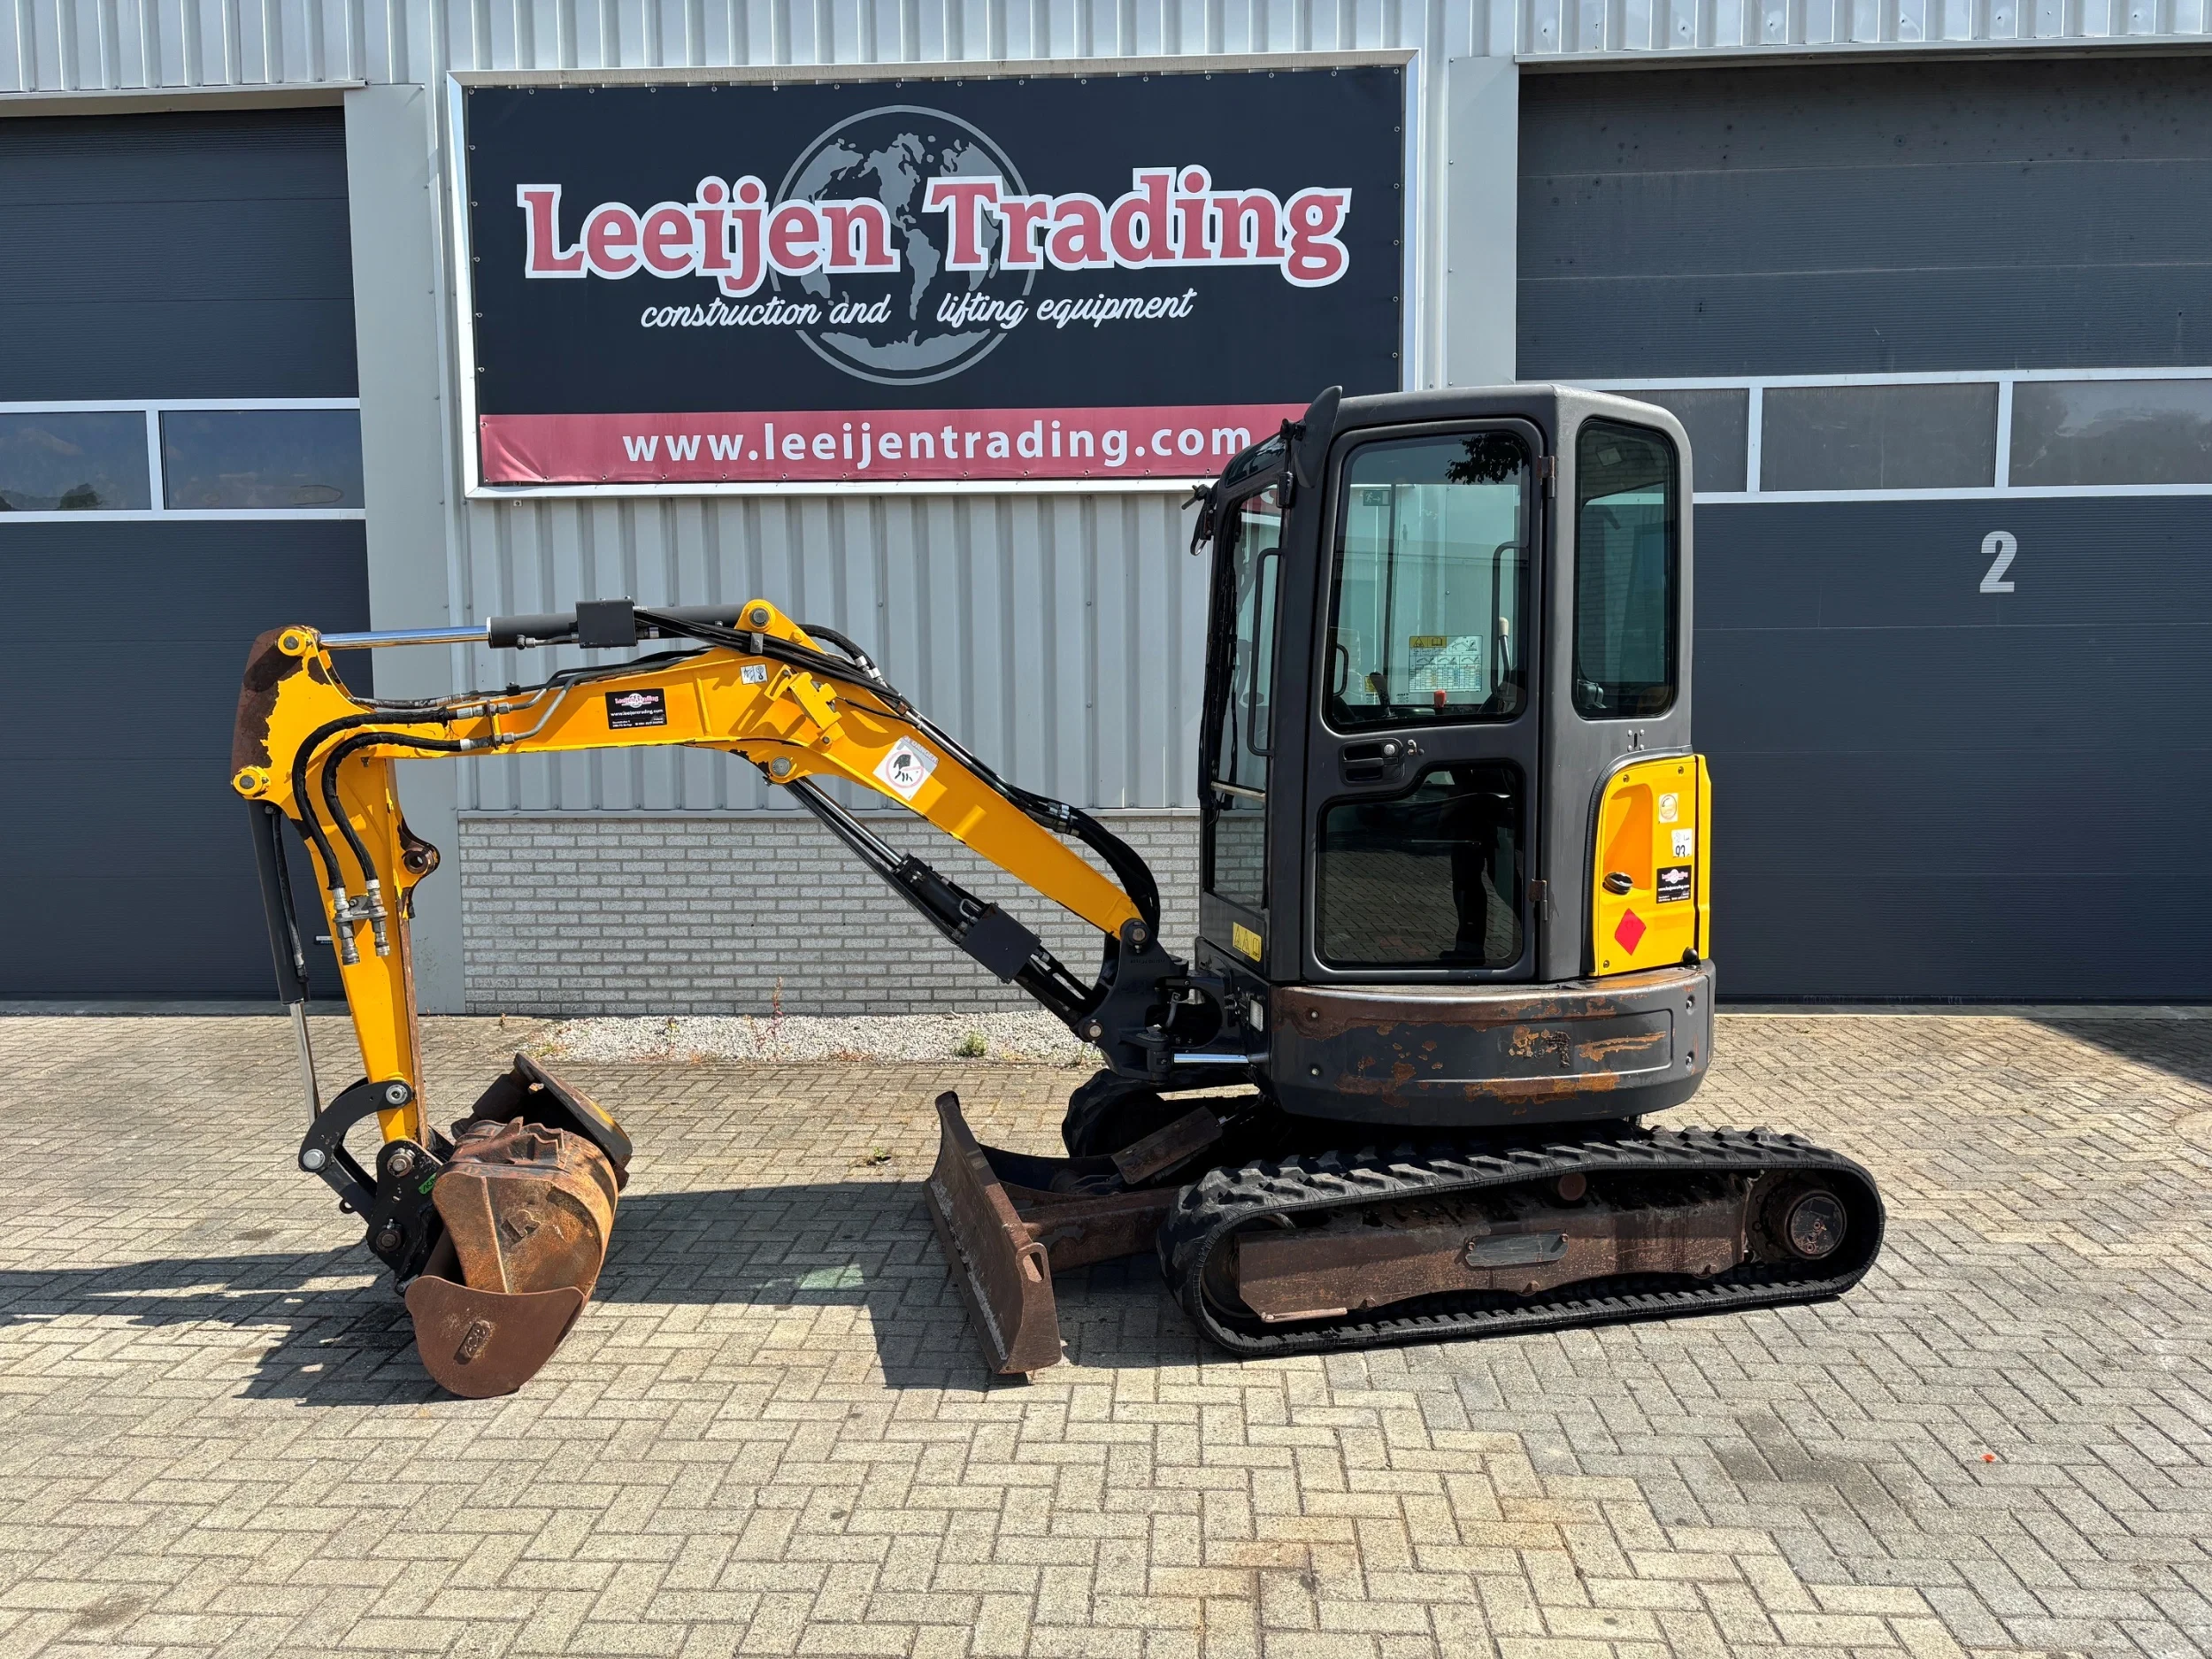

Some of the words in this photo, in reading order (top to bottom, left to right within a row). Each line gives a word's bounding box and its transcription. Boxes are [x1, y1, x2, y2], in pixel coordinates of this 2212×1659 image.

[517, 175, 901, 297] Leeijen
[922, 165, 1353, 288] Trading
[641, 295, 823, 328] construction
[828, 294, 892, 326] and
[936, 290, 1029, 329] lifting
[1036, 288, 1198, 328] equipment
[622, 419, 1251, 470] www.leeijentrading.com
[1979, 530, 2017, 594] 2
